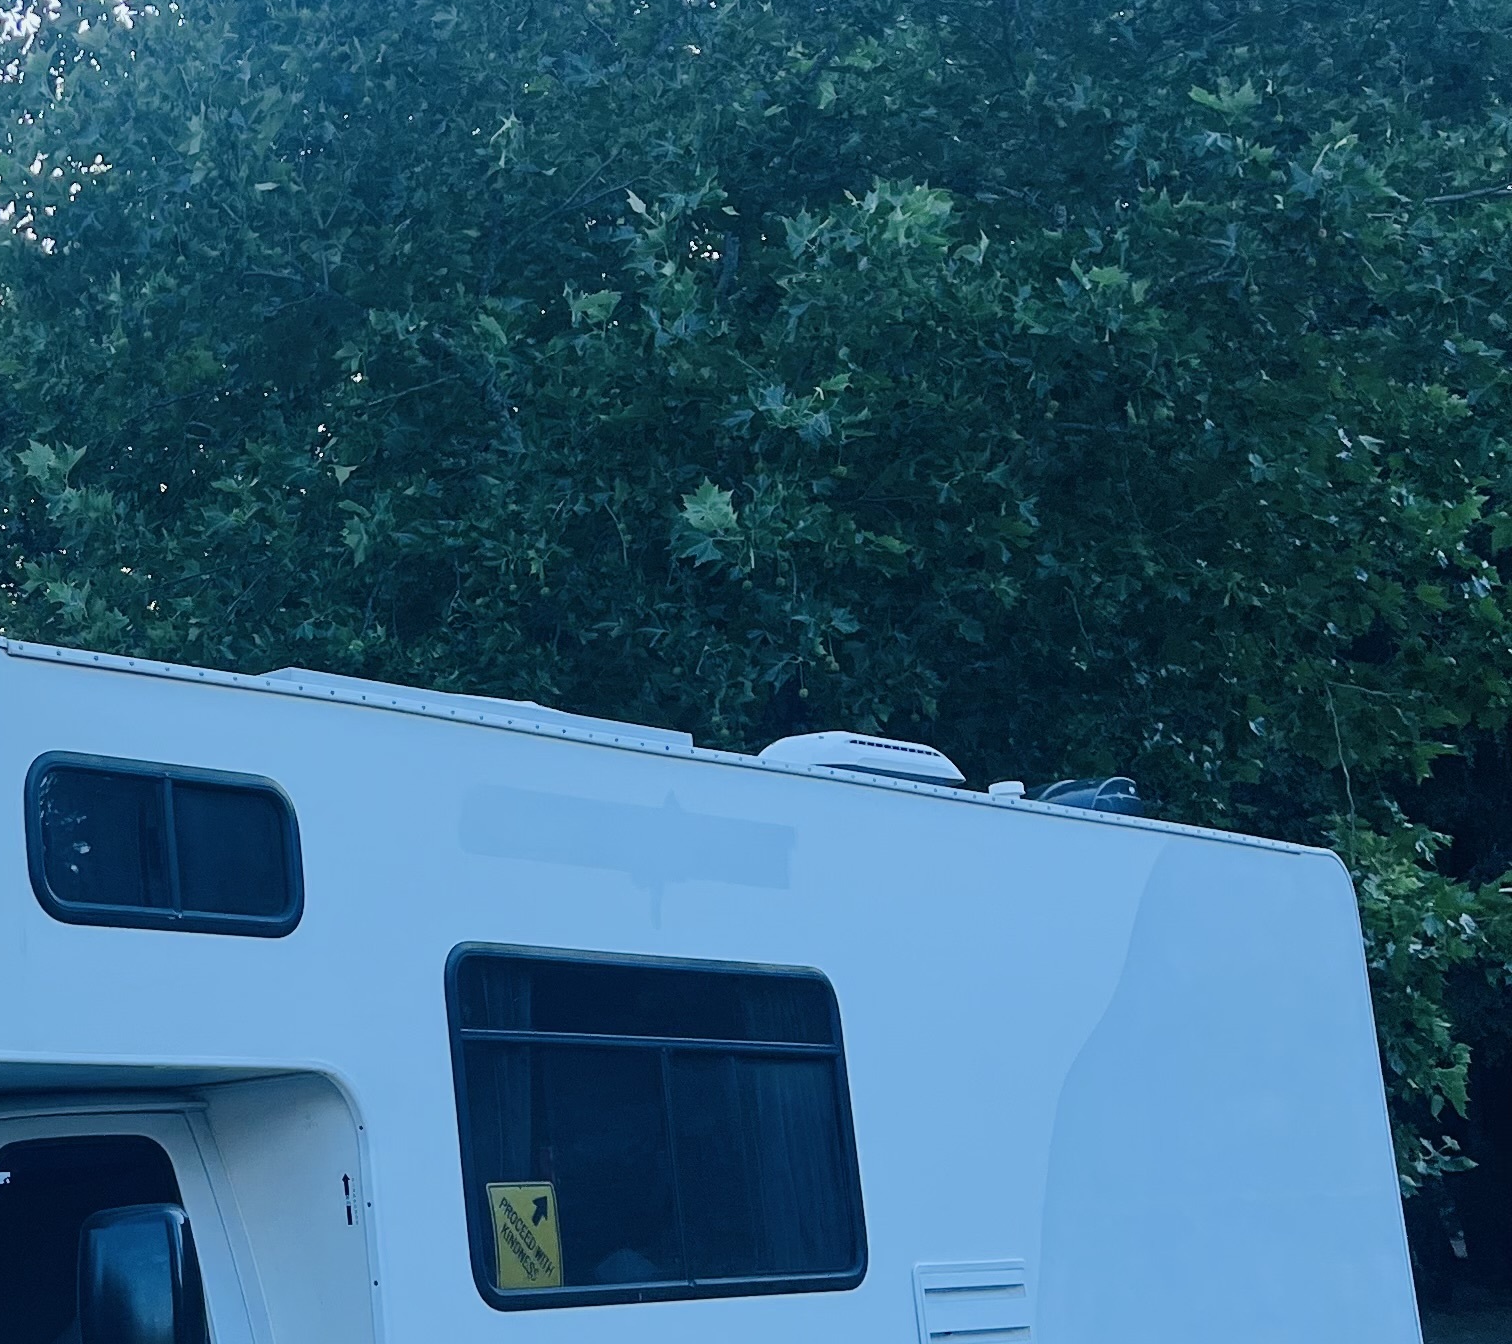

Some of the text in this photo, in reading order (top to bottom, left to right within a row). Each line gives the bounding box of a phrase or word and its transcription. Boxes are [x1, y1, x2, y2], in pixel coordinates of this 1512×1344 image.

[499, 1197, 556, 1277] PROCEED WITH
[500, 1223, 539, 1282] KINDNESS
